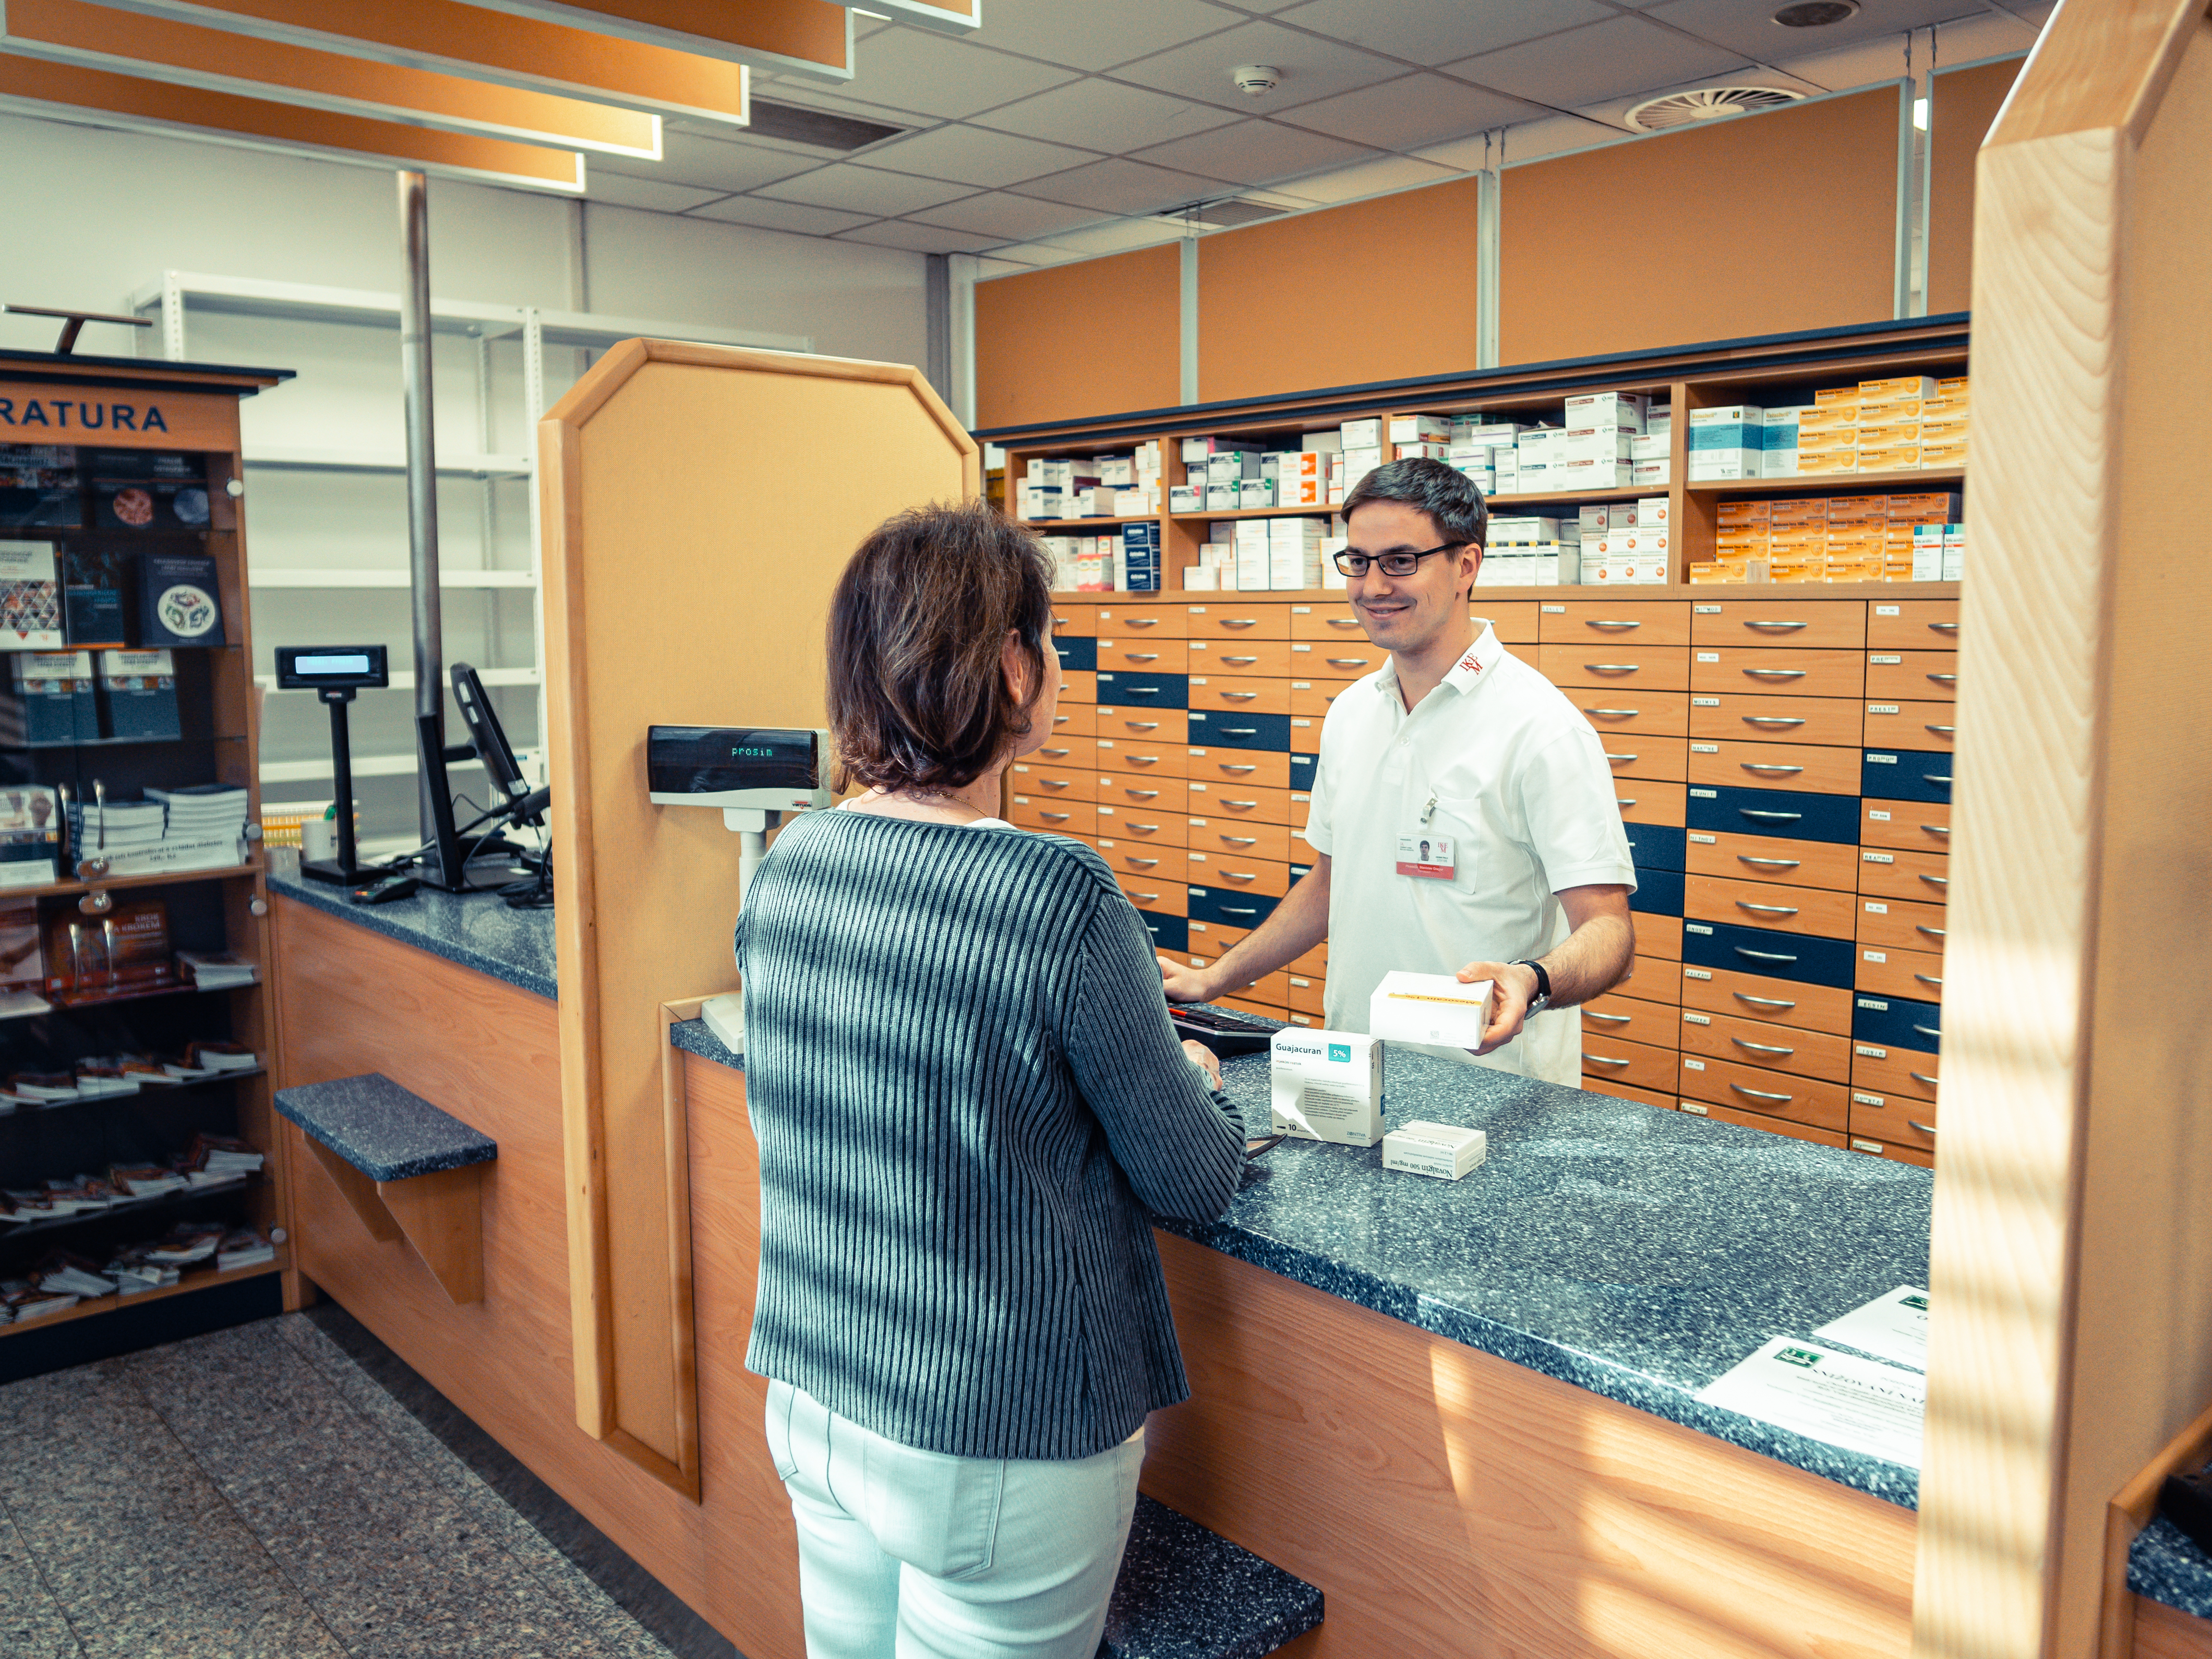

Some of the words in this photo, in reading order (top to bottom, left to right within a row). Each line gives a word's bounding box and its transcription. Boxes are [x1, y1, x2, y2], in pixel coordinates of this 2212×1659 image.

[732, 748, 772, 756] prosim
[1276, 1043, 1321, 1055] Guajacuran
[1333, 1049, 1346, 1057] 5%
[1390, 1159, 1409, 1168] mg/ml
[1422, 1165, 1453, 1177] Novalgin
